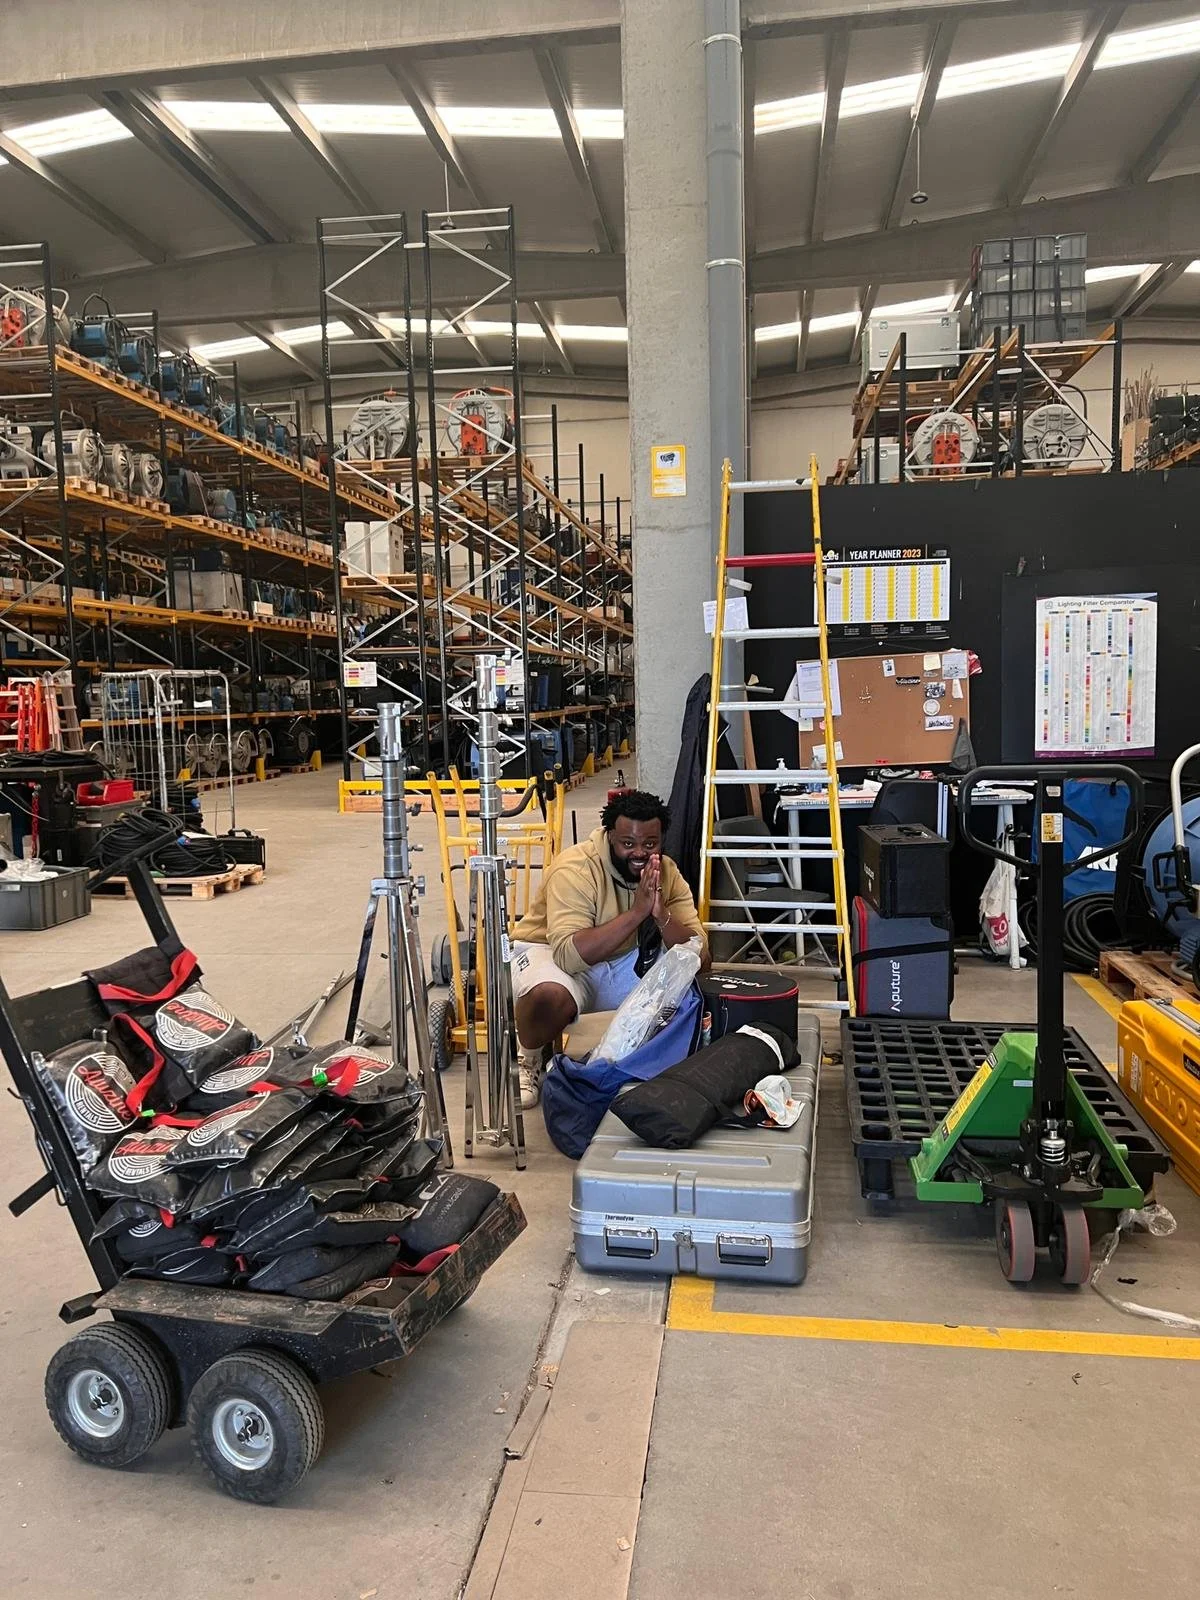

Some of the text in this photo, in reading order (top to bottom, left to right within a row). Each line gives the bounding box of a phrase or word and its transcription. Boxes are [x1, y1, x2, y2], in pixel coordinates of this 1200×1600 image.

[849, 550, 869, 560] YEAR
[869, 549, 901, 560] PLANNER
[902, 548, 921, 559] 2023
[1100, 599, 1135, 607] Comparator
[1077, 846, 1119, 872] AR
[890, 960, 903, 1013] Aputure
[75, 1101, 99, 1125] RENTALS
[124, 1166, 150, 1177] RENTALS
